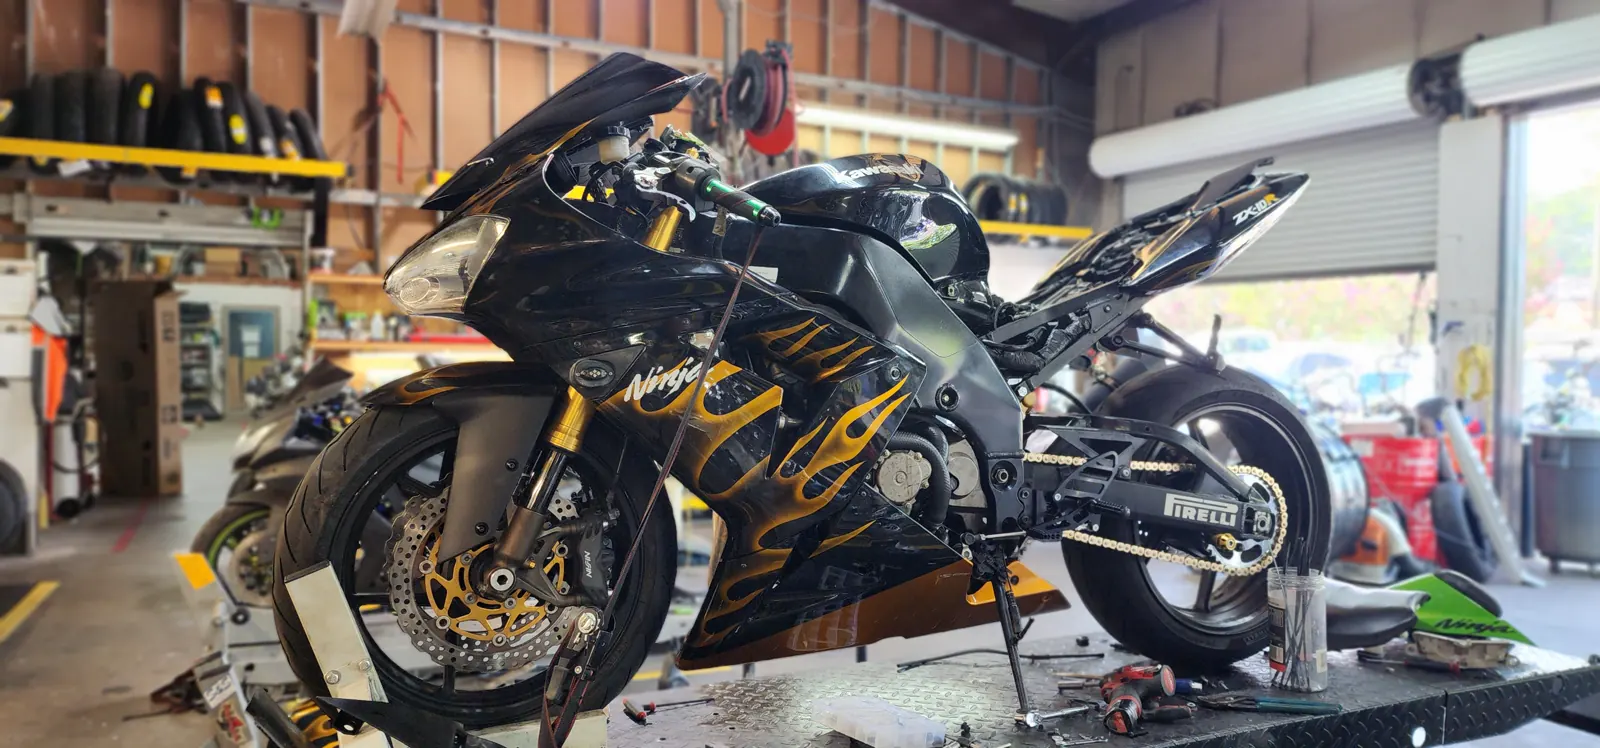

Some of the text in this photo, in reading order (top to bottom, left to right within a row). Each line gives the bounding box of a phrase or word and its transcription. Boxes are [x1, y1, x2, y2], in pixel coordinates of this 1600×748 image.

[1232, 193, 1280, 226] ZX-10R
[623, 356, 714, 402] Ninja
[1163, 493, 1239, 527] PIRELLI
[1434, 618, 1516, 633] Ninja
